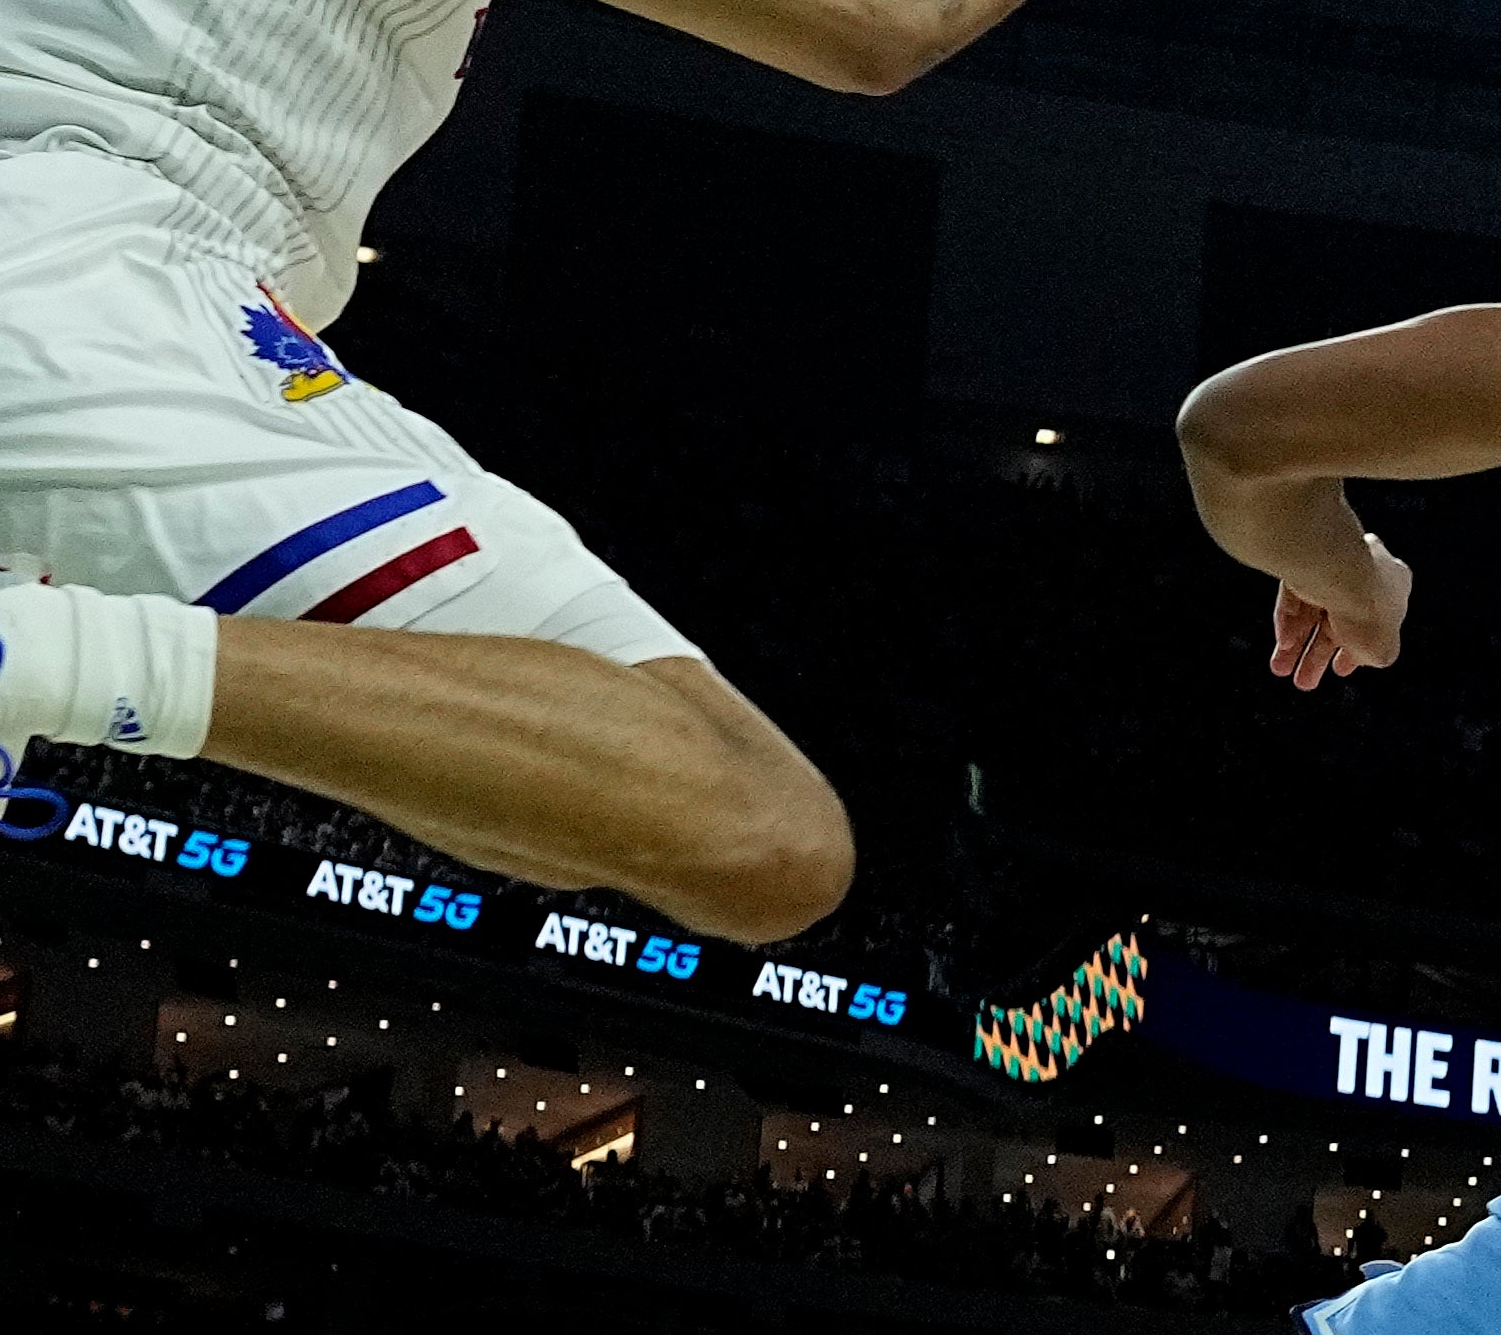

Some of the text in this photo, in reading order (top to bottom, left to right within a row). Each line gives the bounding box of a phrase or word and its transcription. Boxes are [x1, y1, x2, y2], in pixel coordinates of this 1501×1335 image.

[64, 803, 249, 878] AT&T 5G
[307, 858, 481, 930] AT&T 5G
[535, 912, 702, 981] AT&T 5G
[752, 961, 908, 1027] AT&T 5G
[1329, 1015, 1451, 1114] THE
